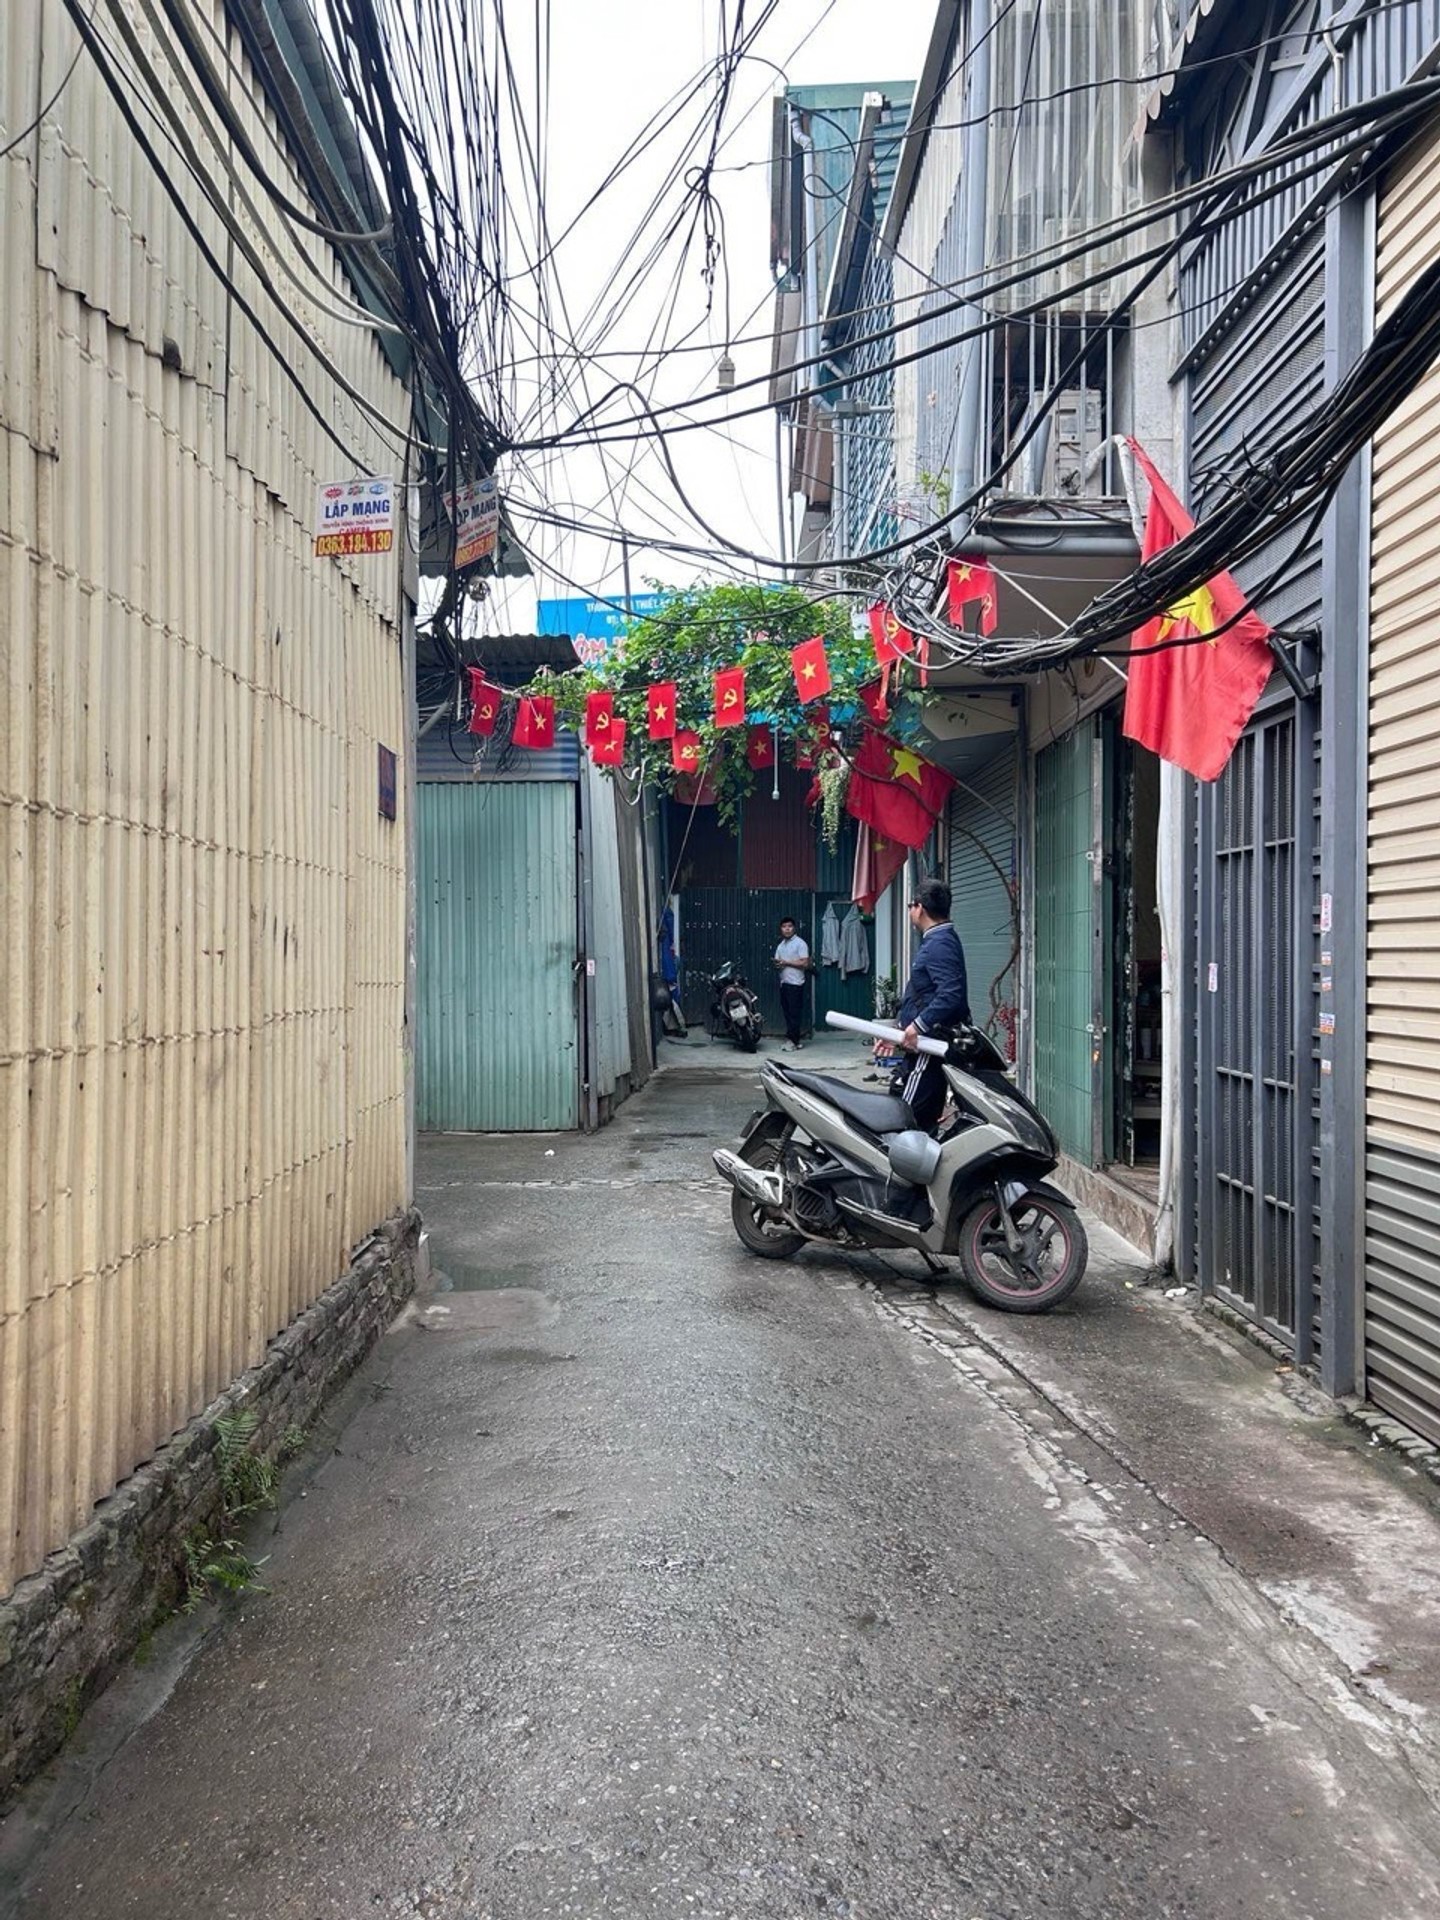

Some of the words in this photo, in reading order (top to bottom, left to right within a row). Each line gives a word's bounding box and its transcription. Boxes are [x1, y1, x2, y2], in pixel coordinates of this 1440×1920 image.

[325, 500, 349, 519] LẮP
[352, 499, 390, 518] MẠNG
[572, 633, 607, 663] ÔM
